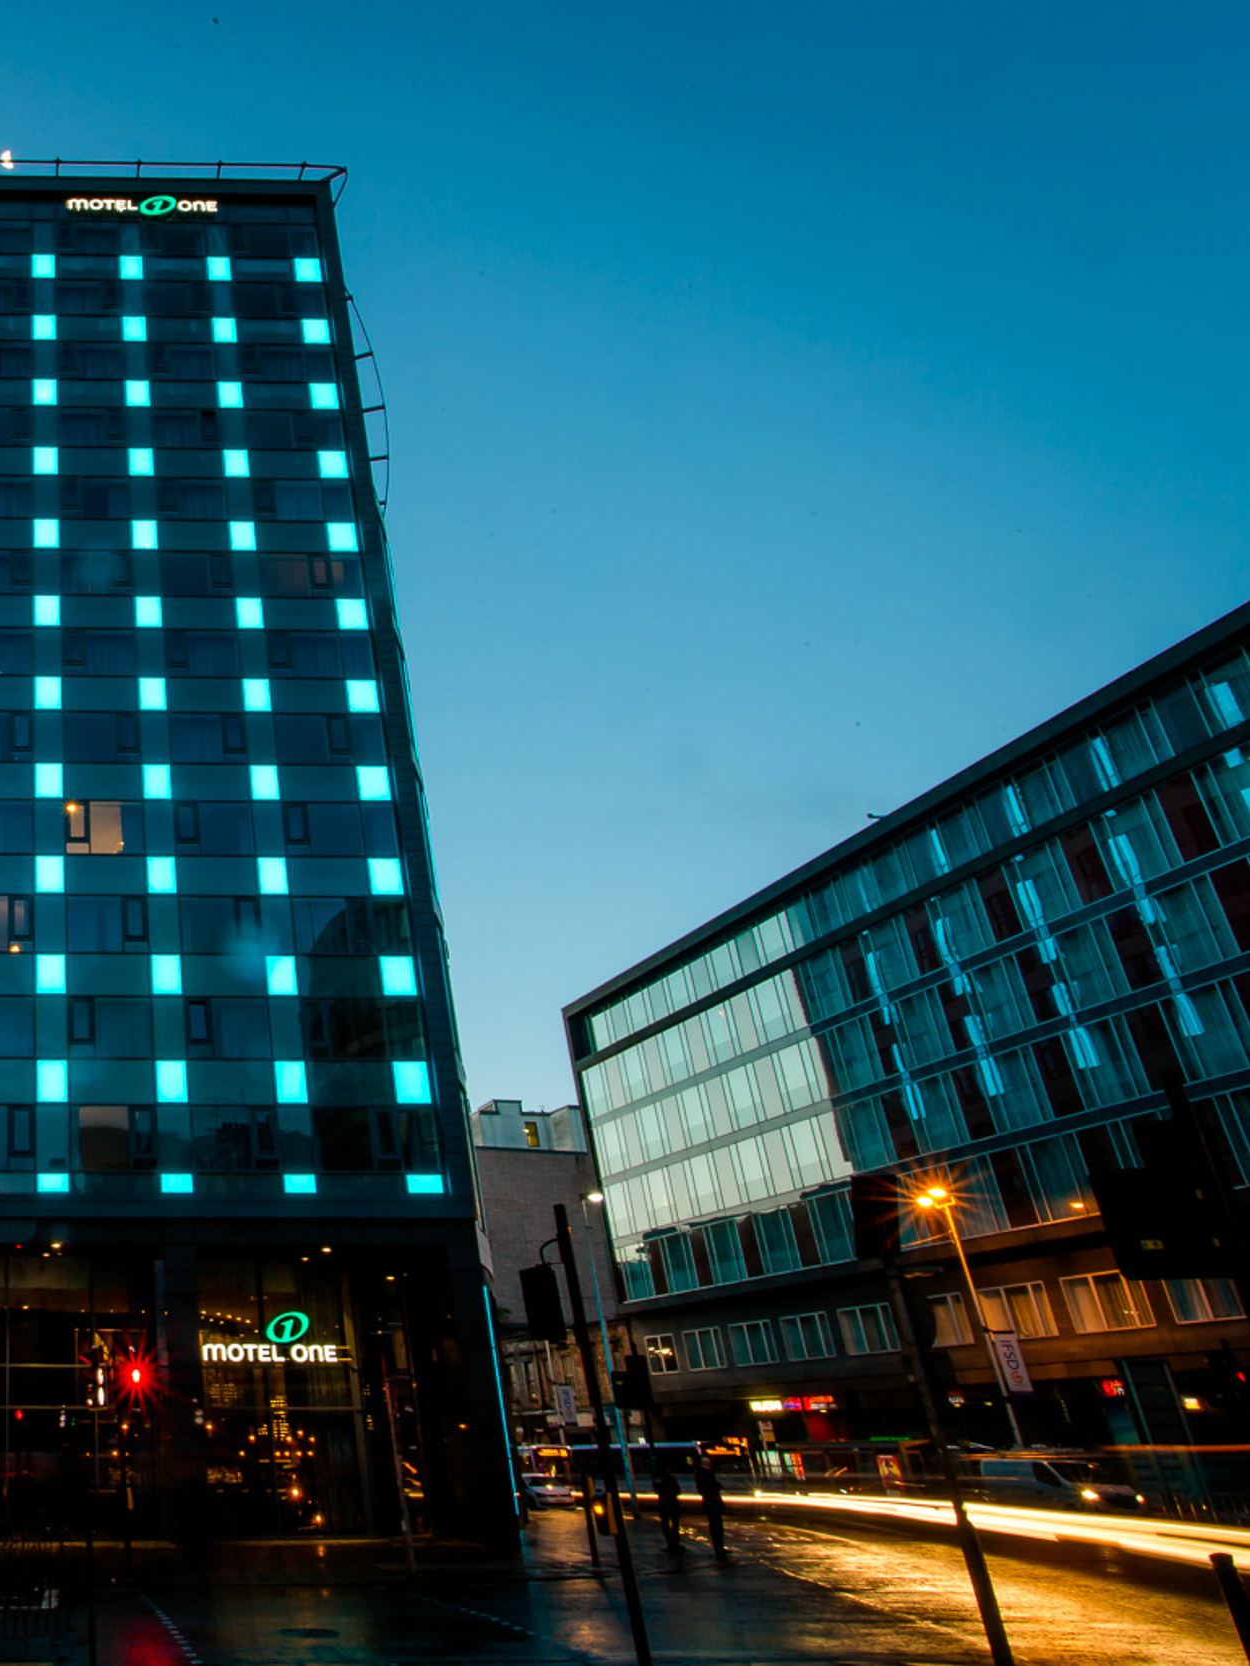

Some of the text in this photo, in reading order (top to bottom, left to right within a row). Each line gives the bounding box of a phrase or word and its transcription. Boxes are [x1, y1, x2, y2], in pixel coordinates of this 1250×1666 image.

[66, 197, 138, 212] MOTEL
[177, 199, 218, 212] ONE
[202, 1343, 339, 1362] MOTEL ONE
[1000, 1340, 1019, 1370] IFSD
